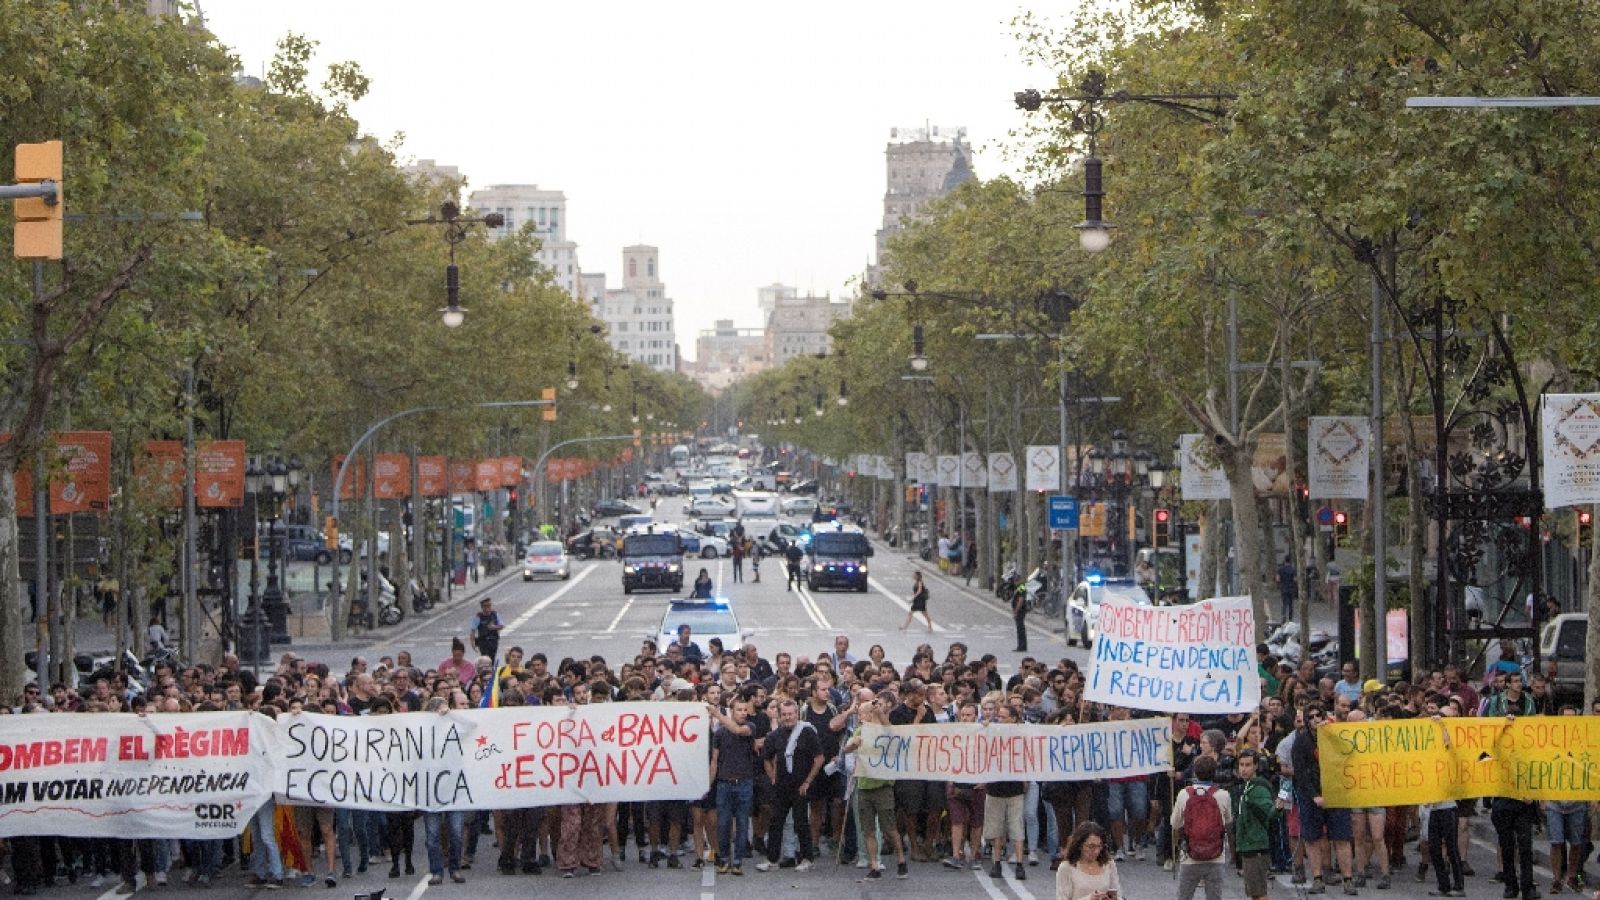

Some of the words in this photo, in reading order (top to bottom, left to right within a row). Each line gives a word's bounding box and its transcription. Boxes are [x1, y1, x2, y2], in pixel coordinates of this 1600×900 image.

[1098, 602, 1154, 641] TOMBEM
[1156, 610, 1174, 643] EL
[1232, 608, 1253, 647] 78
[119, 735, 149, 761] EL
[154, 725, 249, 760] RÈGIM
[287, 722, 464, 763] SOBIRANIA
[513, 718, 597, 751] FORA
[618, 713, 700, 748] BANC
[916, 734, 1048, 775] TOSSUDAMENT
[1049, 726, 1170, 774] REPUBLICANES
[1521, 723, 1600, 750] SOCIAL
[0, 782, 29, 805] M
[33, 778, 104, 802] VOTAR
[106, 769, 249, 797] INDEPENDÈNCIA
[287, 766, 474, 806] ECONÒMICA
[494, 746, 678, 790] d'ESPANYA
[1343, 760, 1425, 790] SERVEIS
[1516, 753, 1600, 791] REPÚBLIC
[195, 803, 236, 820] CDR
